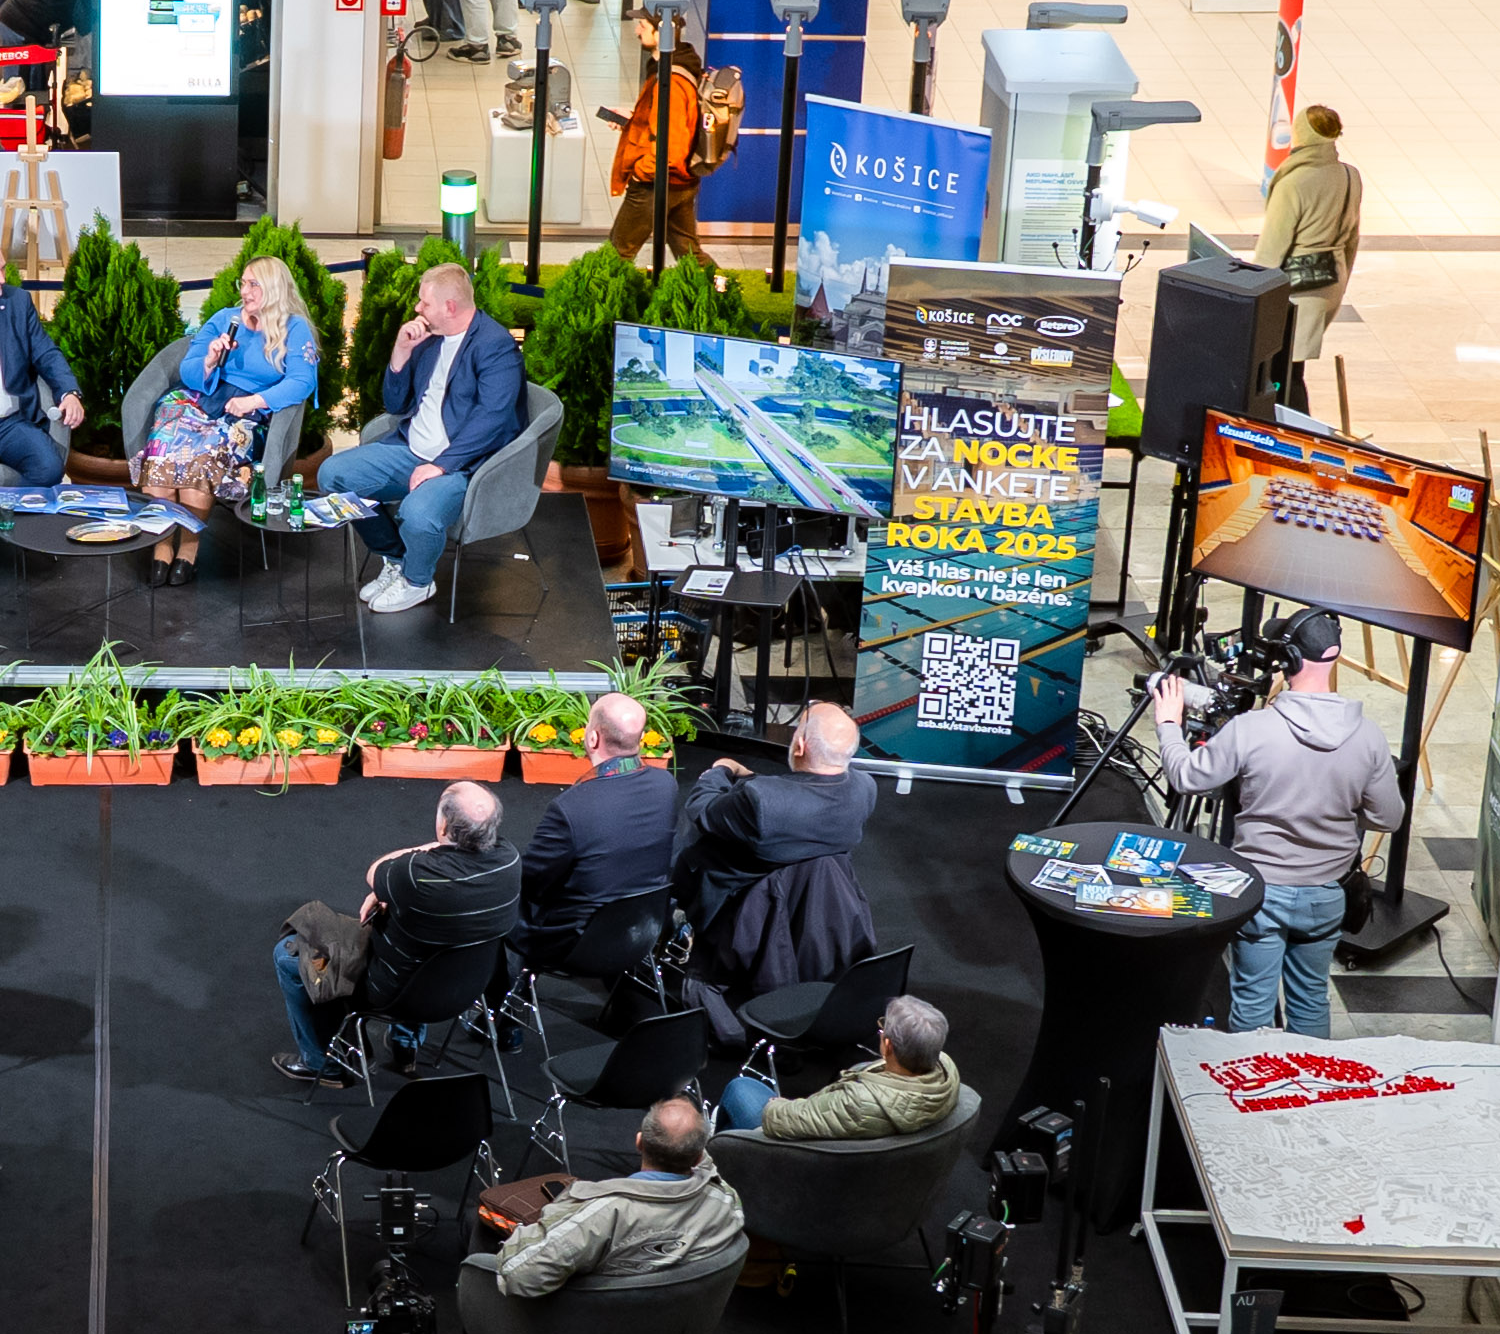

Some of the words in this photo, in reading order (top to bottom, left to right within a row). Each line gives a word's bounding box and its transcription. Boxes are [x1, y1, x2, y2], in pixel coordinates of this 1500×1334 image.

[856, 155, 959, 194] KOŠICE
[928, 309, 975, 324] KOŠICE
[1040, 320, 1079, 331] Betpres
[904, 406, 1077, 442] HLASUJTE
[899, 436, 946, 461] ZA
[953, 439, 1079, 471] NOCKE
[903, 465, 925, 490] V
[930, 469, 1070, 501] ANKETE
[913, 496, 1054, 530] STAVBA
[886, 523, 987, 553] ROKA
[994, 530, 1077, 560] 2025
[886, 558, 924, 577] Váš
[927, 560, 970, 581] hlas
[974, 565, 1005, 584] nie
[1008, 567, 1031, 588] je
[1034, 570, 1067, 588] len
[881, 577, 970, 600] kvapkou
[974, 588, 986, 599] v
[991, 585, 1072, 607] bazéne.
[917, 718, 1011, 736] asb.sk/stavbaroka
